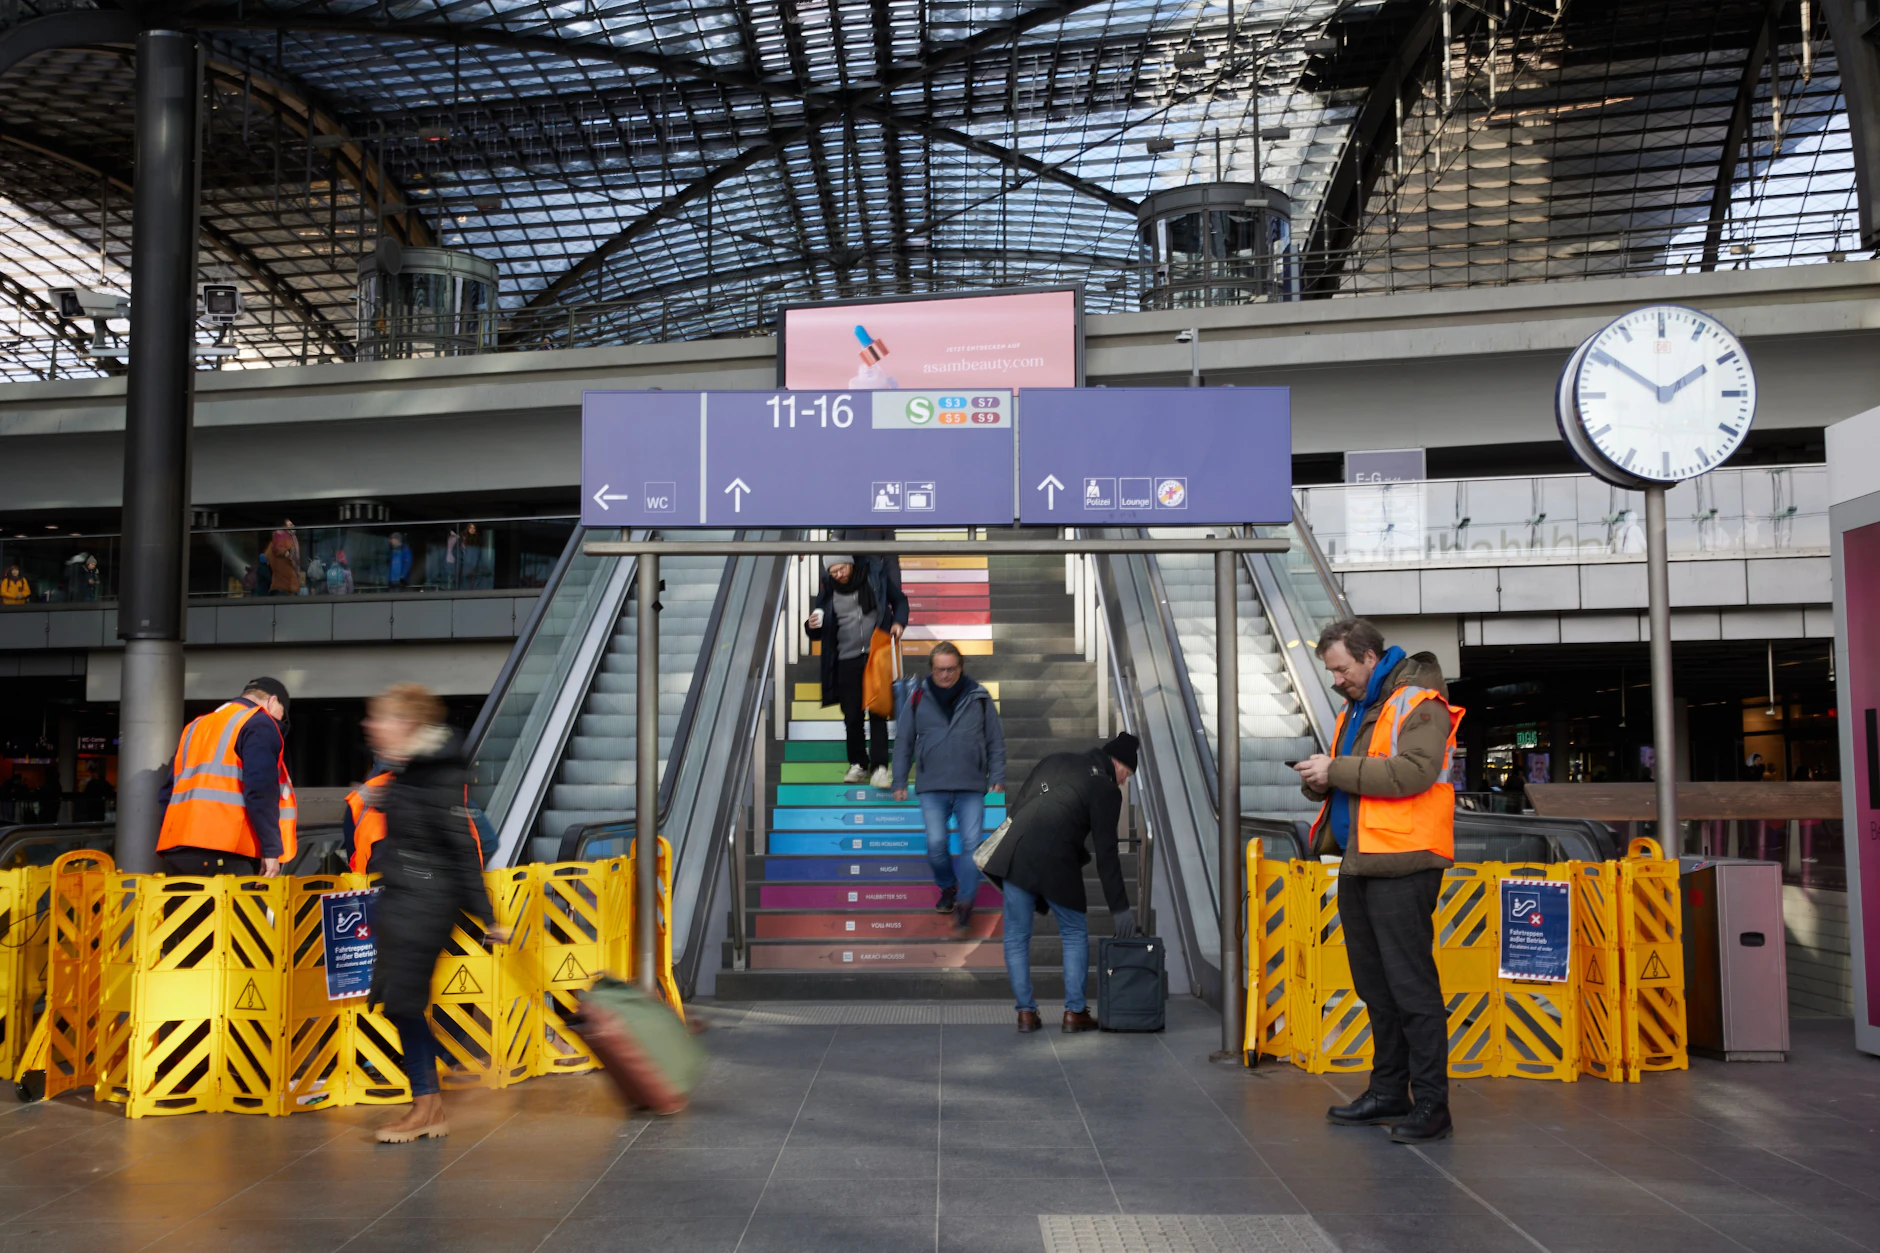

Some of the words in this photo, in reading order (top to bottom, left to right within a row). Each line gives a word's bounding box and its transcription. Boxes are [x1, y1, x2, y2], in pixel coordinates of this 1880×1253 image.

[967, 343, 1005, 351] ENTDECKEN
[923, 357, 1044, 373] asambeauty.com
[766, 395, 854, 428] 11-16
[646, 497, 669, 509] WC
[1086, 498, 1111, 506] Polizei
[1121, 498, 1150, 508] Lounge
[335, 943, 373, 953] Fahrtreppen
[354, 949, 377, 958] Betrieb
